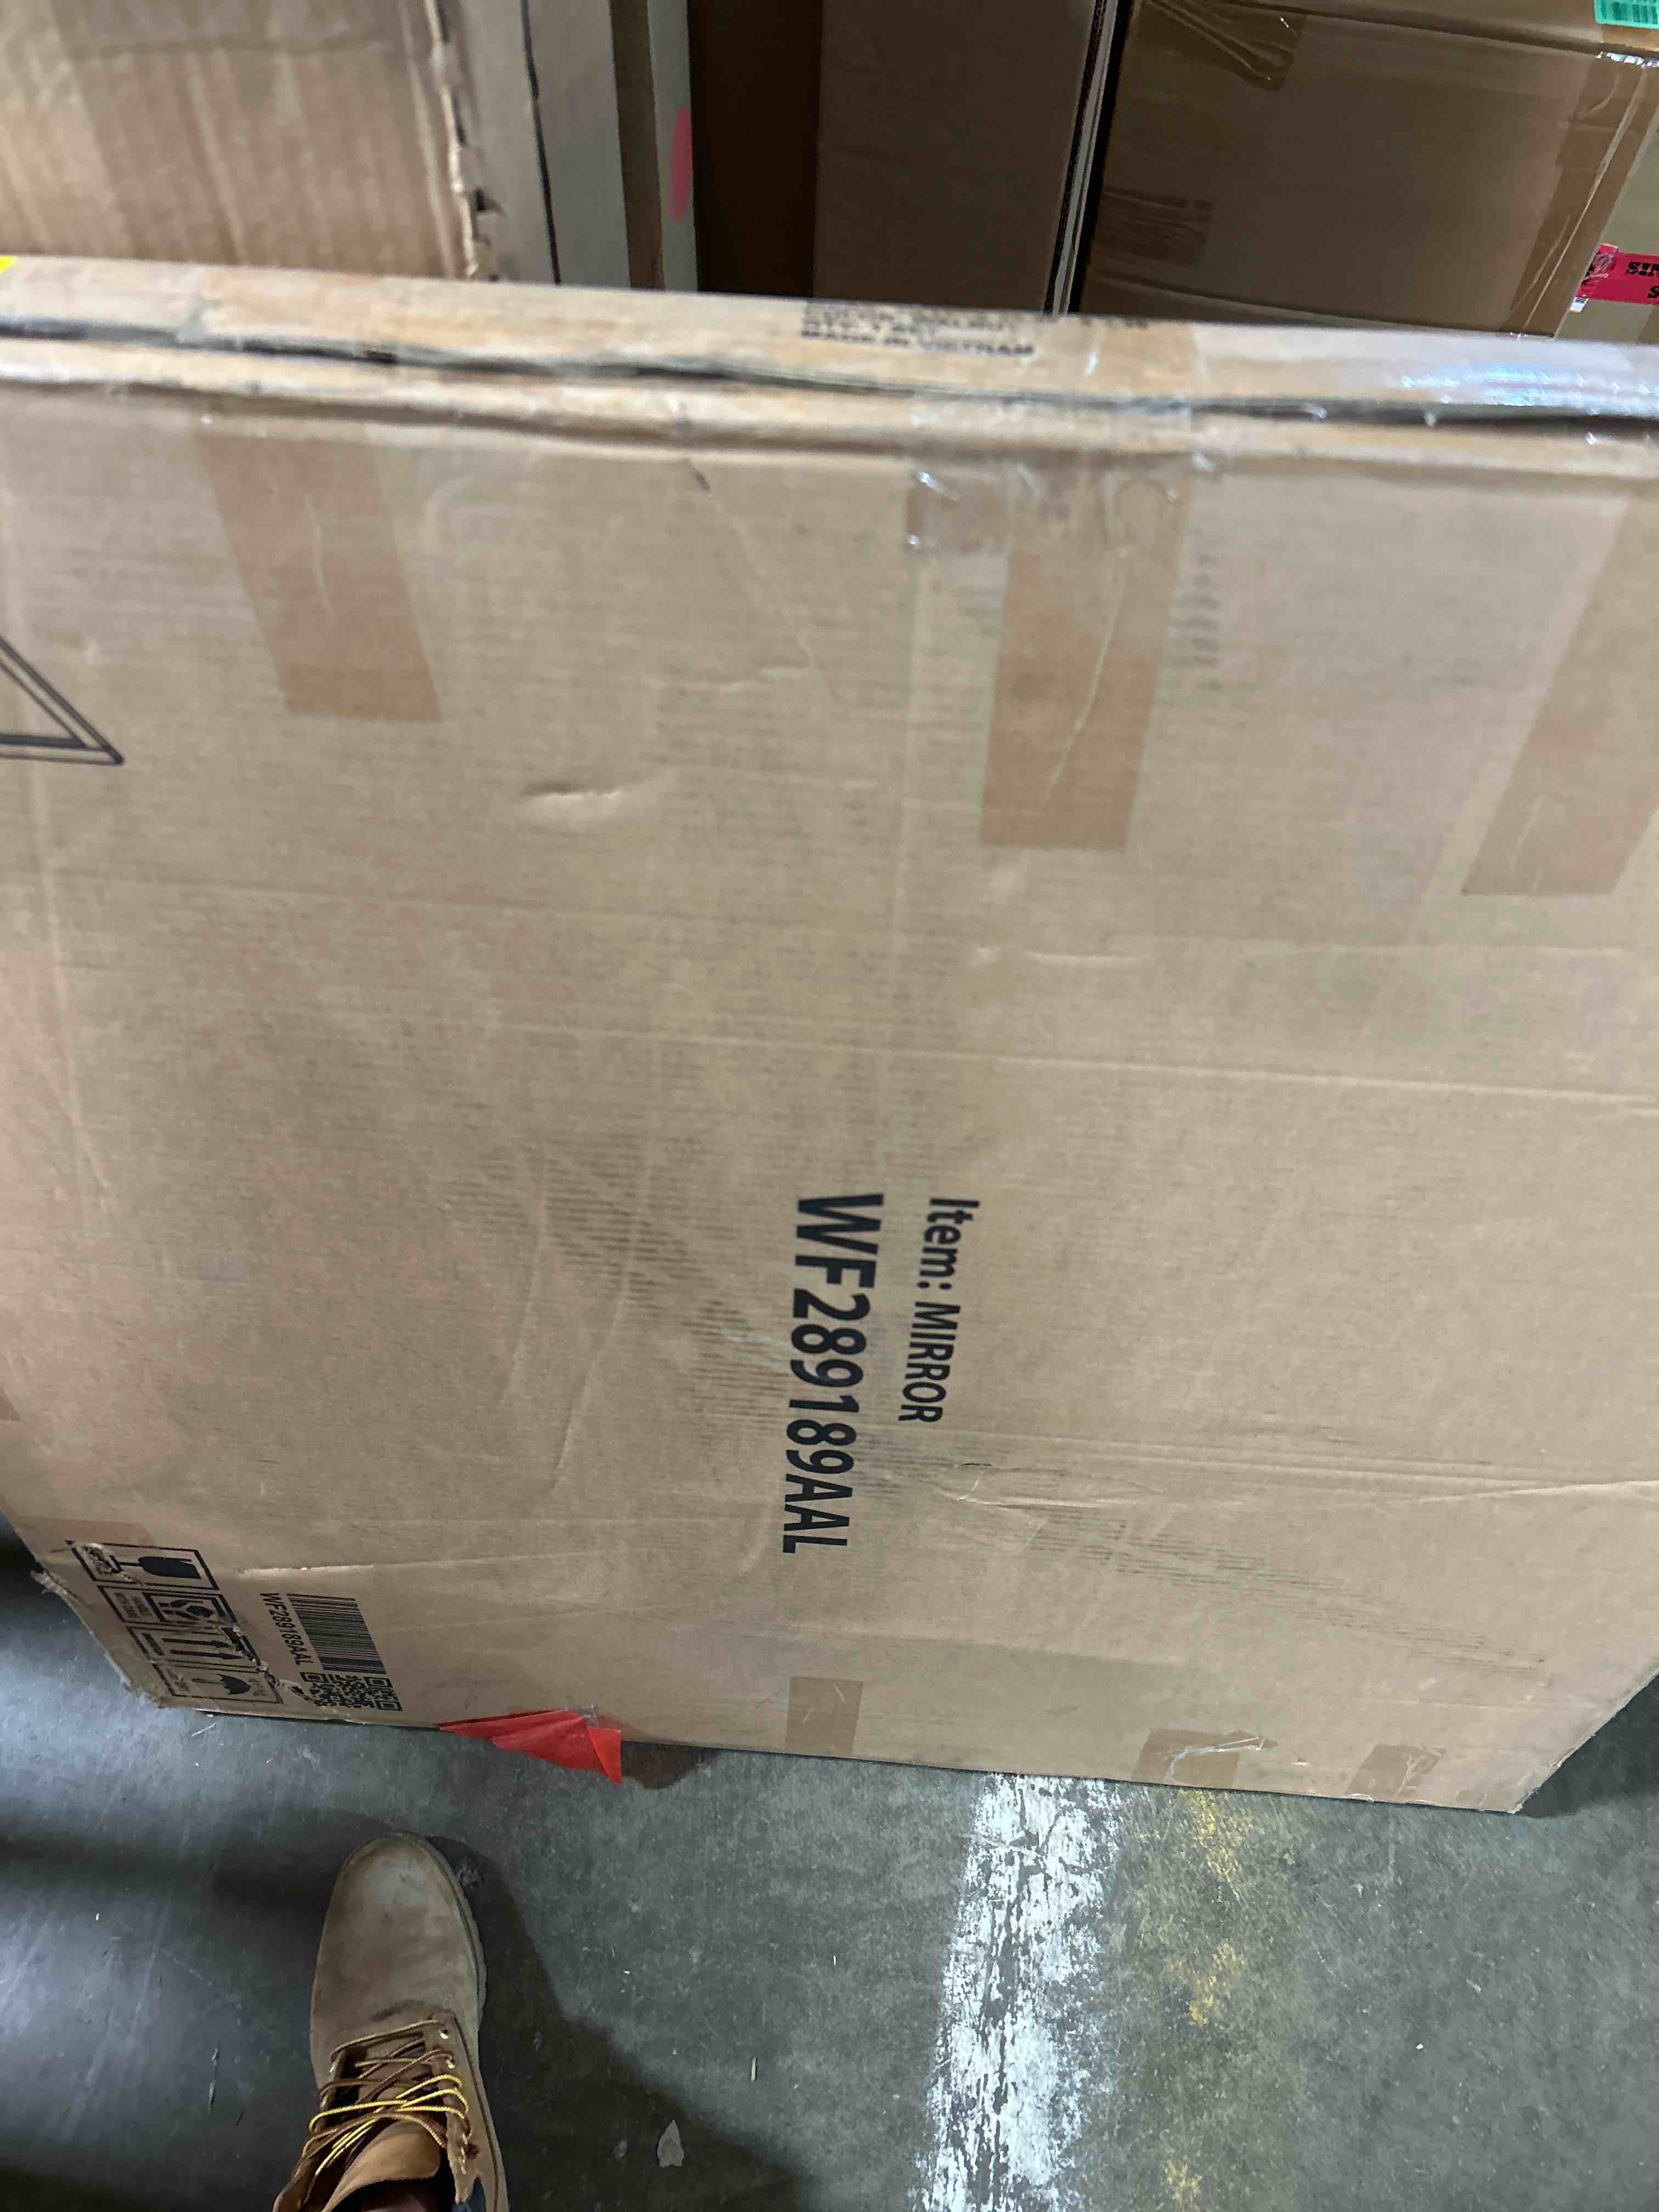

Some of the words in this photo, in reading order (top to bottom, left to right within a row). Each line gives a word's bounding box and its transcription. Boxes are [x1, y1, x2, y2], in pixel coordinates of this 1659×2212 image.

[917, 1197, 980, 1290] Item:
[782, 1193, 884, 1554] WF289189AAL
[898, 1301, 961, 1423] MIRROR
[260, 1593, 314, 1666] WF289189AAL
